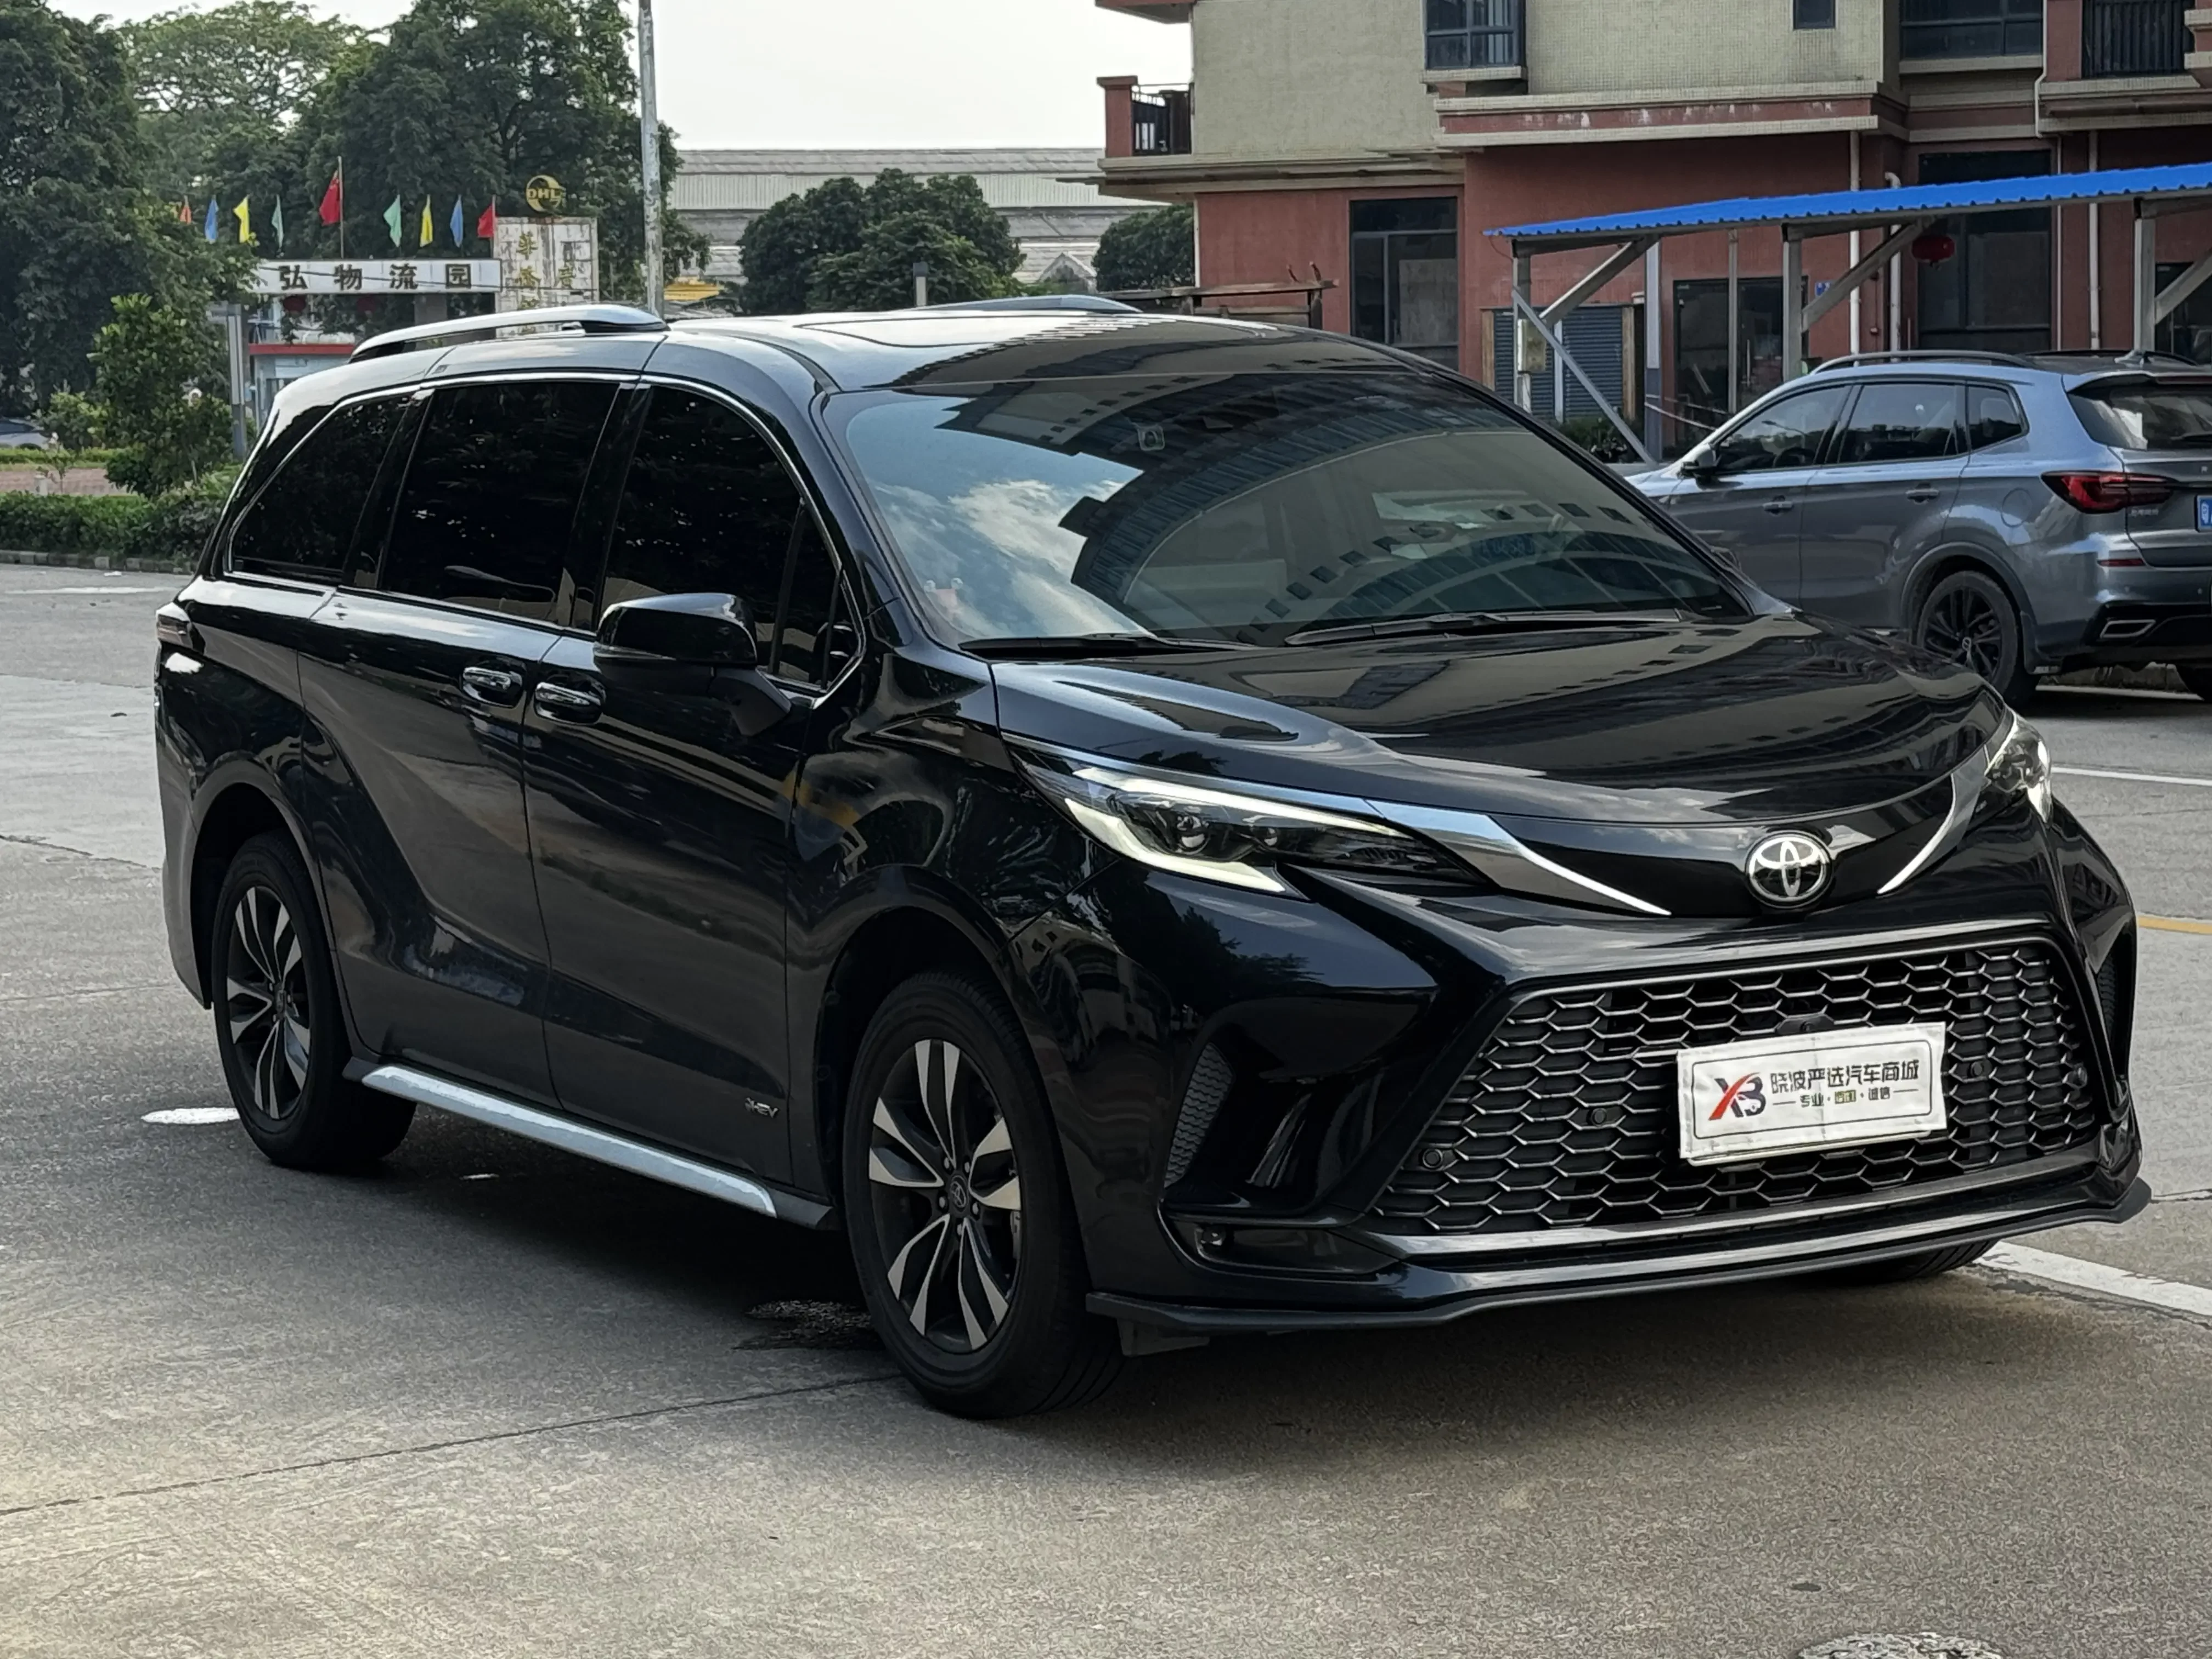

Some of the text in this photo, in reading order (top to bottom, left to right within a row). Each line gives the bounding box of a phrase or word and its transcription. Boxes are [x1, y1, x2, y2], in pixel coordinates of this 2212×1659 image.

[279, 263, 472, 290] 弘物流园
[1770, 1059, 1919, 1093] 晓波严选汽车商城
